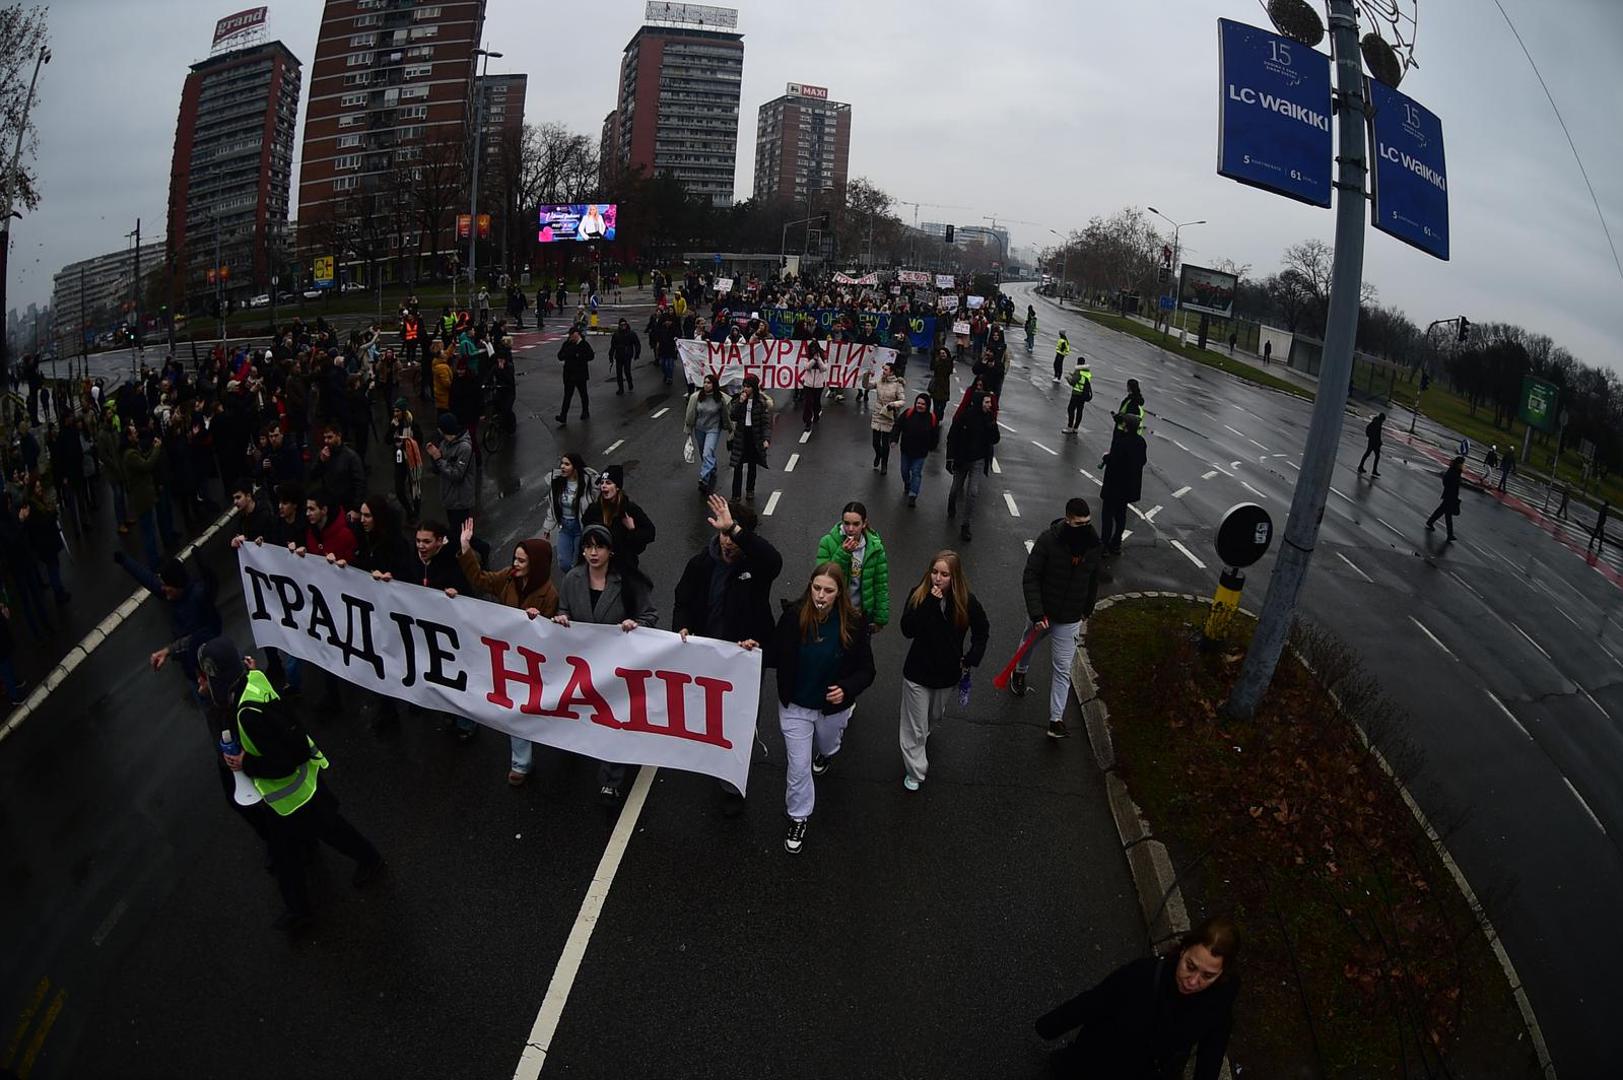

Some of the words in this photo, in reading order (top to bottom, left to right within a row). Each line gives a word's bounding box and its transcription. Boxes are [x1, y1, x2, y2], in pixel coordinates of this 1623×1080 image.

[215, 9, 263, 35] grand
[1268, 40, 1291, 66] 15
[803, 86, 826, 97] MAXI
[1229, 84, 1256, 104] LC
[1404, 103, 1421, 129] 15
[1380, 142, 1399, 163] LC
[1243, 155, 1250, 164] 5
[1290, 169, 1302, 181] 61
[761, 308, 808, 324] ТРАЖИМ
[743, 364, 860, 390] БЛОКДИ
[244, 565, 386, 681] ГРАД
[389, 612, 468, 692] ЈЕ
[480, 635, 734, 750] НАШ
